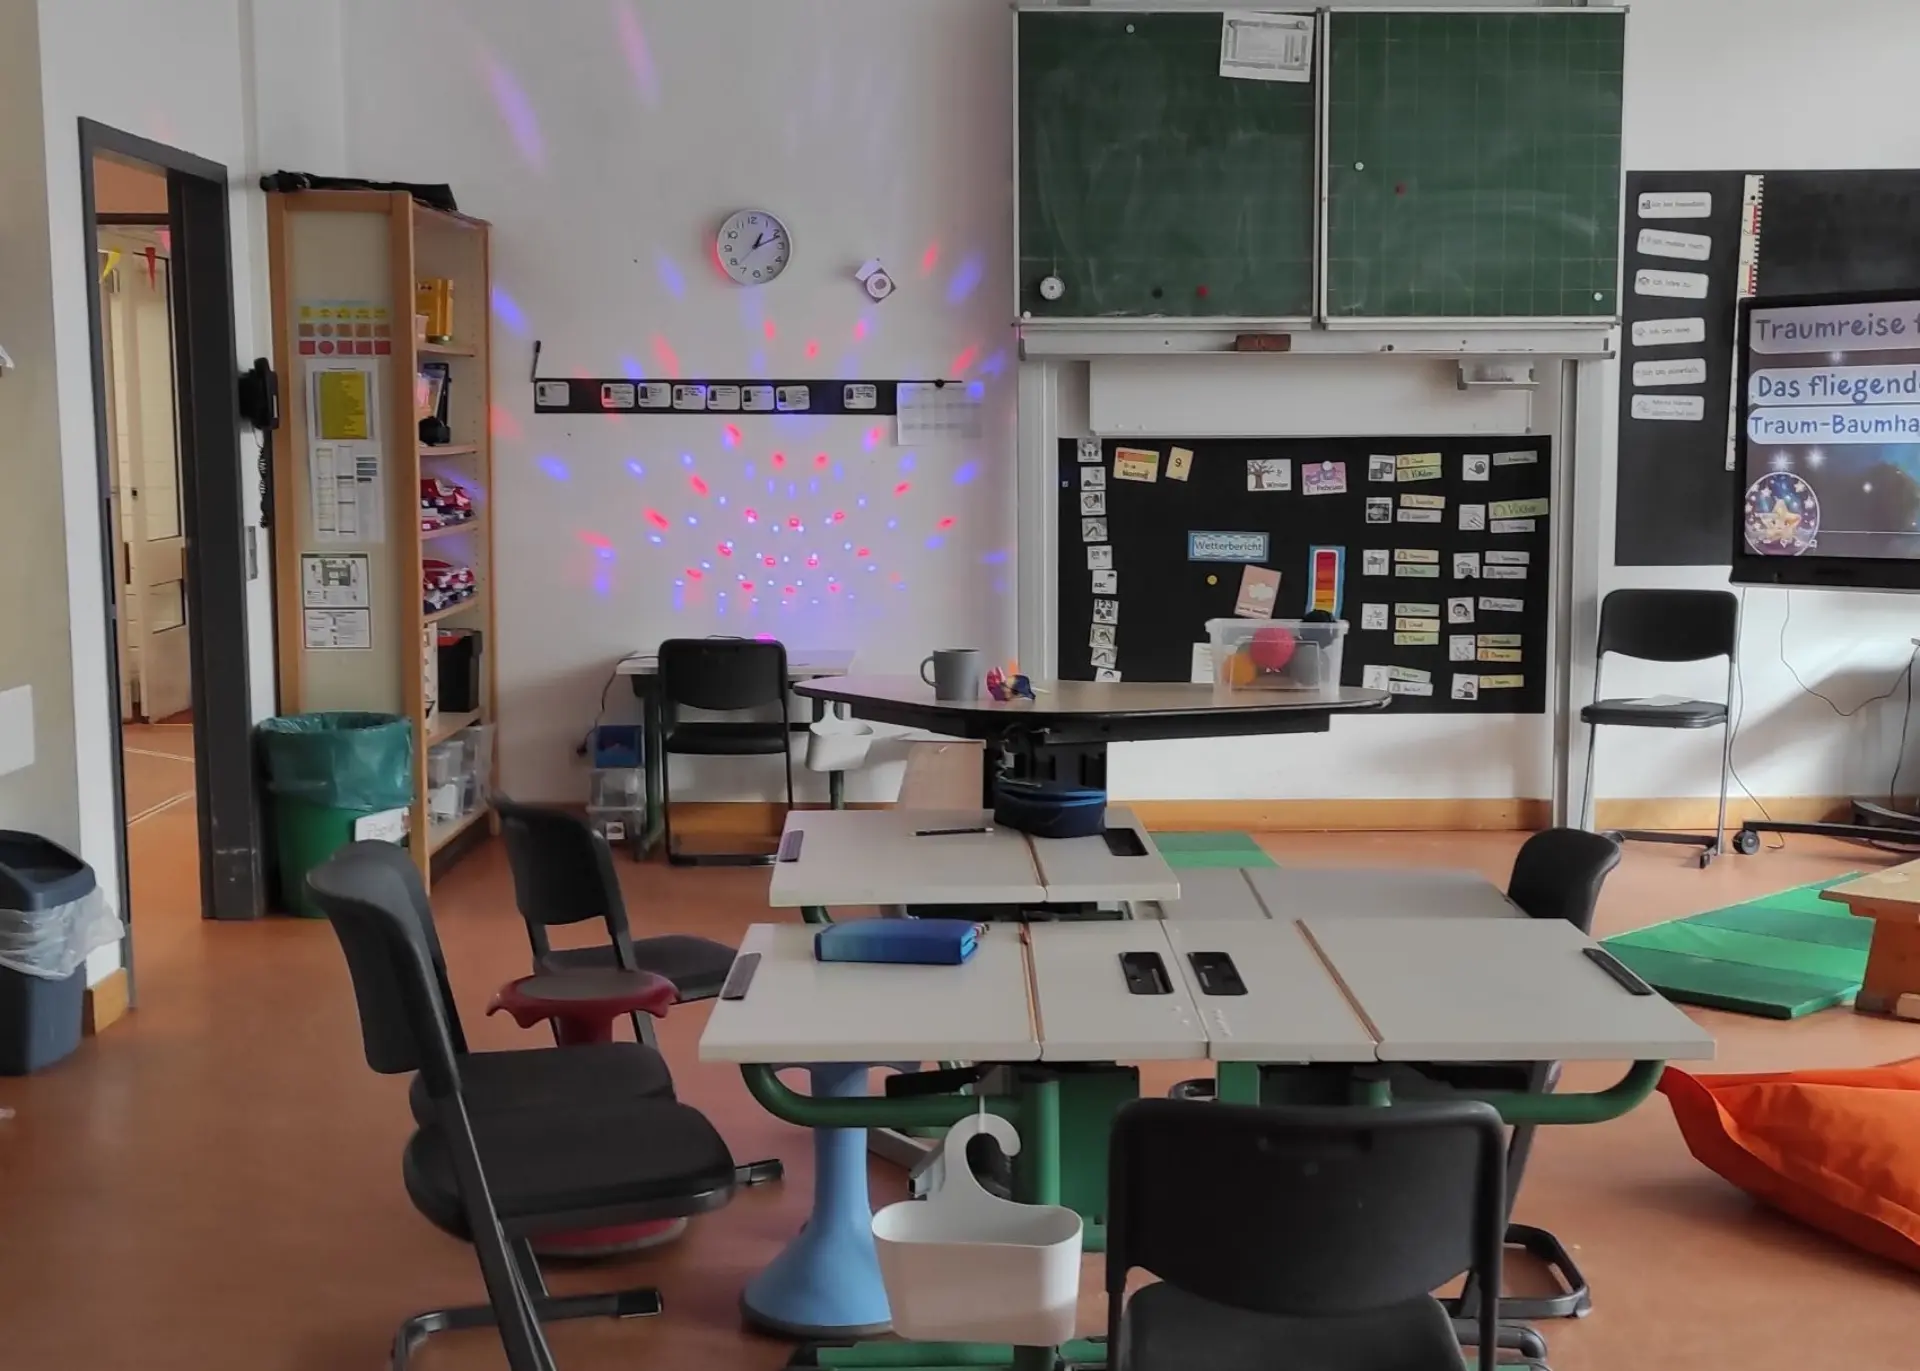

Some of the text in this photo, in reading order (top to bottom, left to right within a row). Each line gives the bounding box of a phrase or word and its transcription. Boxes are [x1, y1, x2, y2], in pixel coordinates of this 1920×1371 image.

[747, 216, 757, 225] 12
[728, 231, 738, 239] 10
[778, 242, 785, 250] 3
[730, 258, 738, 266] 8
[775, 256, 782, 264] 4
[740, 266, 747, 275] 7
[753, 270, 761, 278] 6
[767, 266, 774, 274] 5
[1755, 312, 1905, 341] Traumreise
[1758, 370, 1920, 404] Das fliegend
[1195, 540, 1263, 551] Wetterbericht
[1095, 599, 1113, 610] 123
